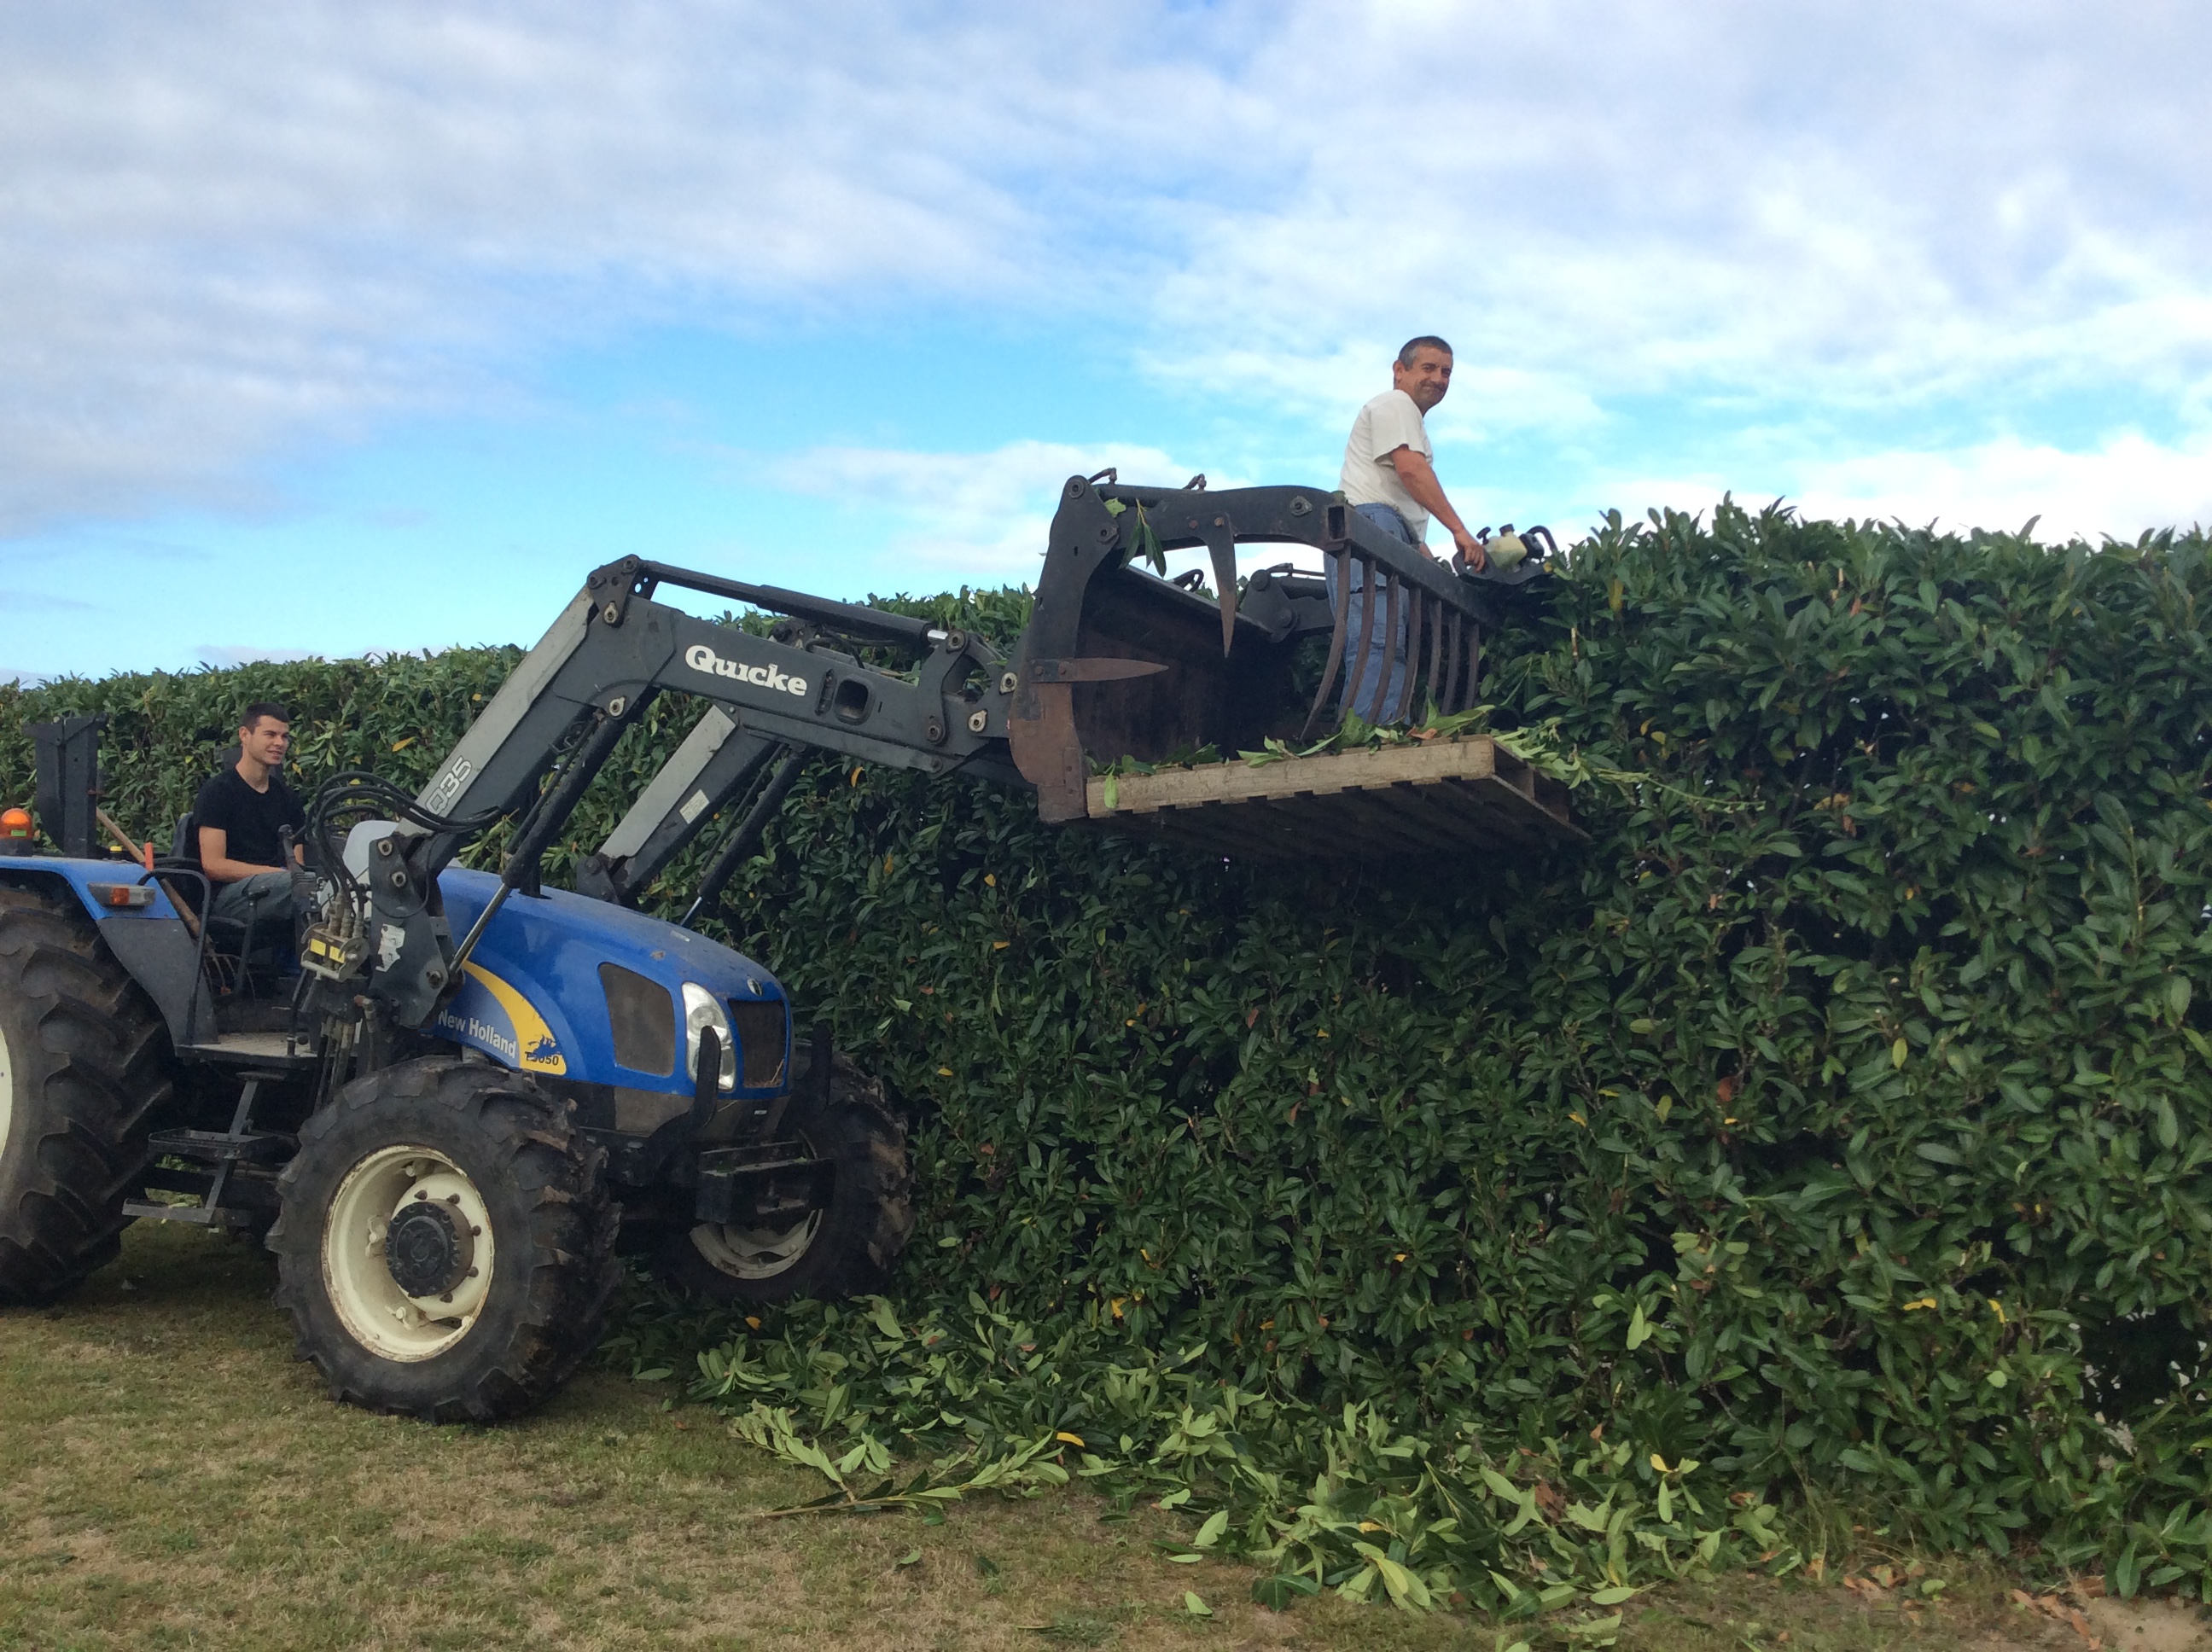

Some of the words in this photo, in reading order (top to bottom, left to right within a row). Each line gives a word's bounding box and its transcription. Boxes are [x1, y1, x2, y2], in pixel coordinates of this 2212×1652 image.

[685, 645, 807, 696] Quicke
[425, 755, 473, 816] Q35
[438, 1009, 467, 1032] New
[469, 1017, 517, 1059] Holland
[524, 1050, 560, 1066] T050
